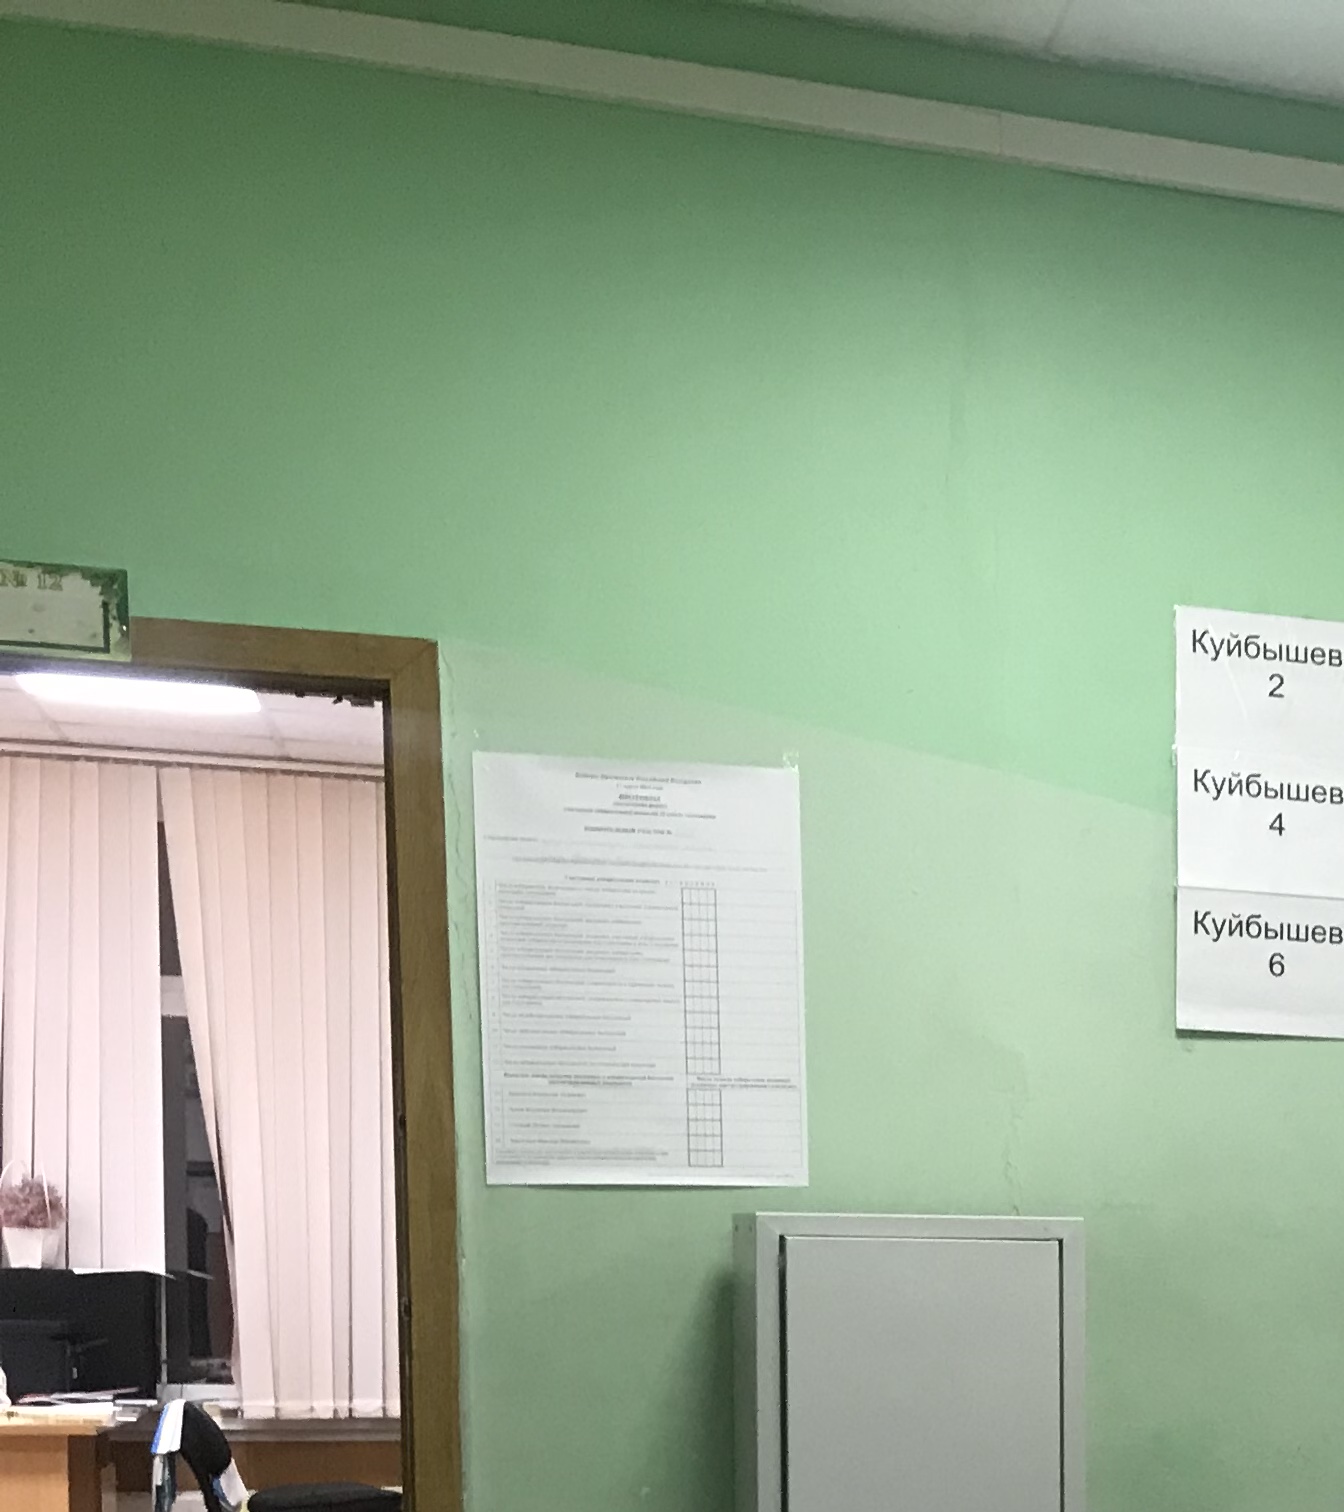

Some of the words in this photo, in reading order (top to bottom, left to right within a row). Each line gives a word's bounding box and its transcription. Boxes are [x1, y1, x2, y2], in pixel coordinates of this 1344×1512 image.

[1268, 673, 1284, 698] 2
[1268, 812, 1285, 836] 4
[1268, 952, 1285, 977] 6
